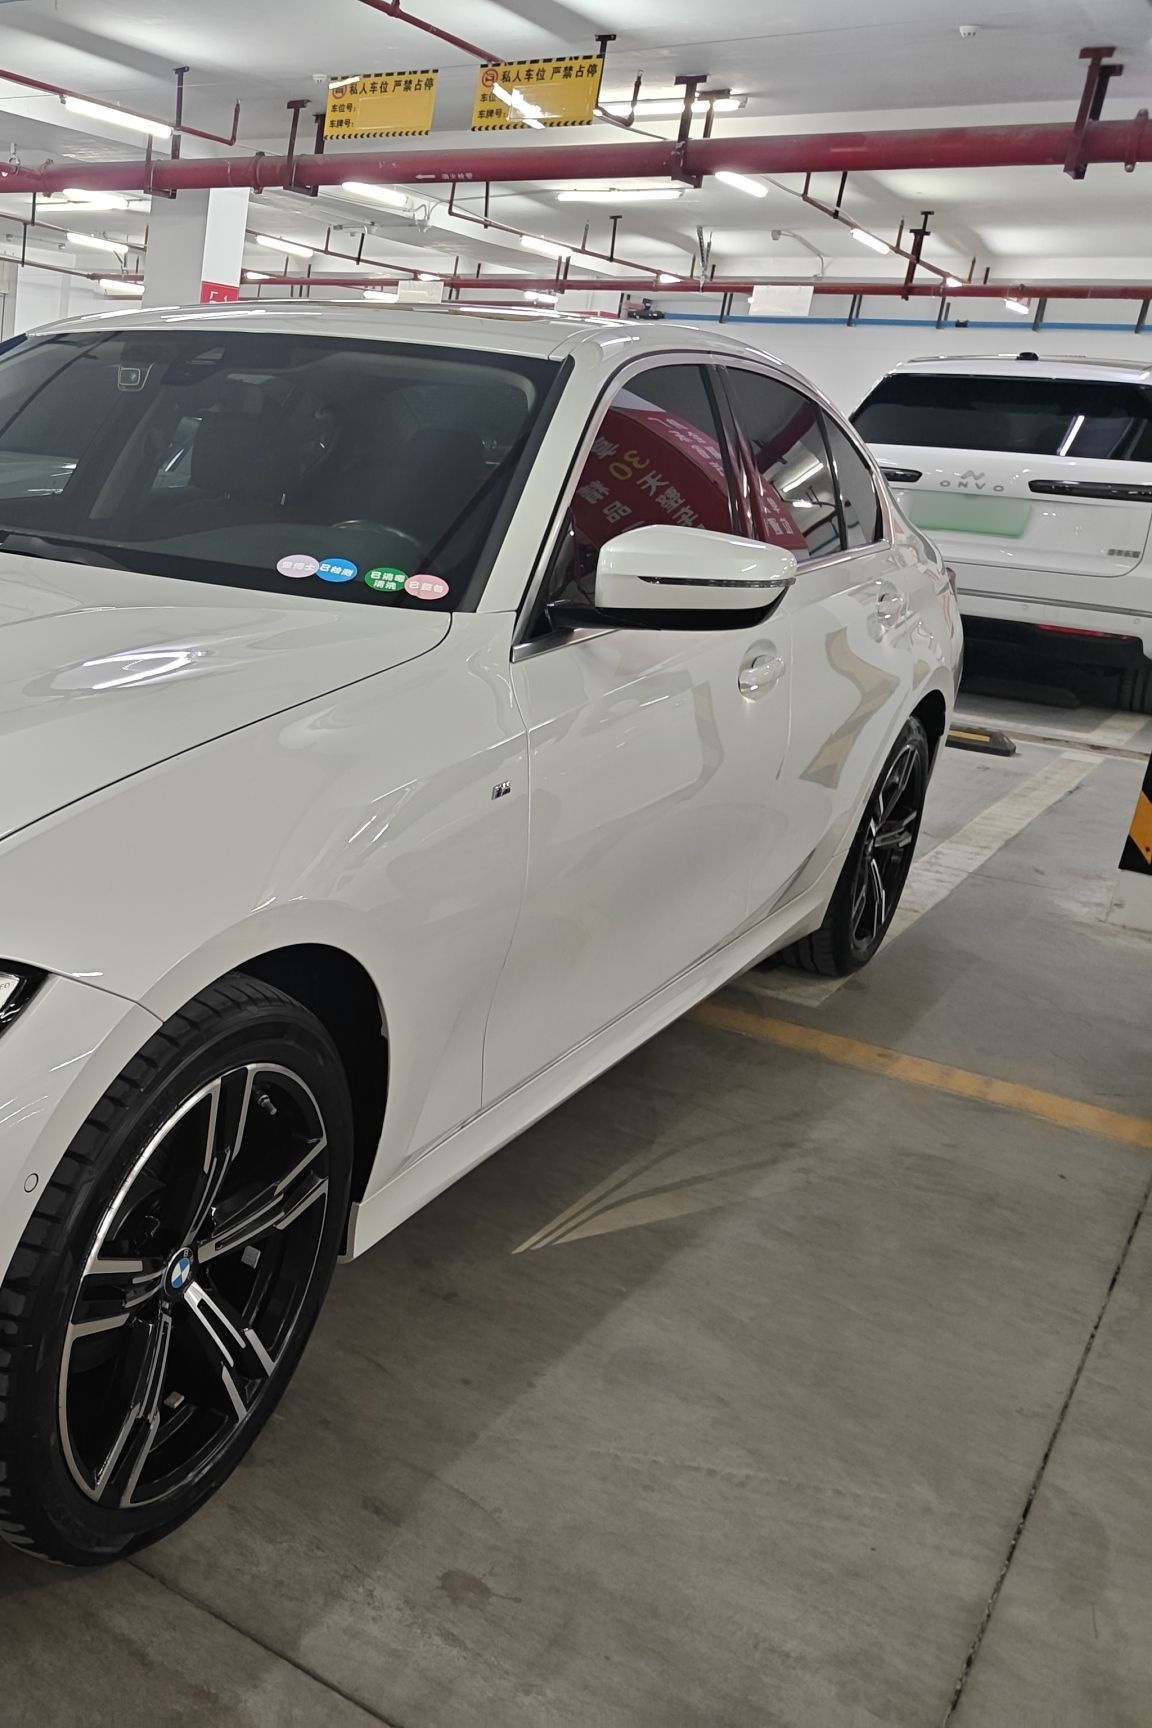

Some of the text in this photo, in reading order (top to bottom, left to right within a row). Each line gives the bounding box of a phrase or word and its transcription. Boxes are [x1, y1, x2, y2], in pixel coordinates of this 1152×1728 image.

[501, 64, 598, 83] 私人车位 严禁占停
[349, 78, 434, 95] 私人车位 严禁占停
[940, 480, 1004, 492] ONVO
